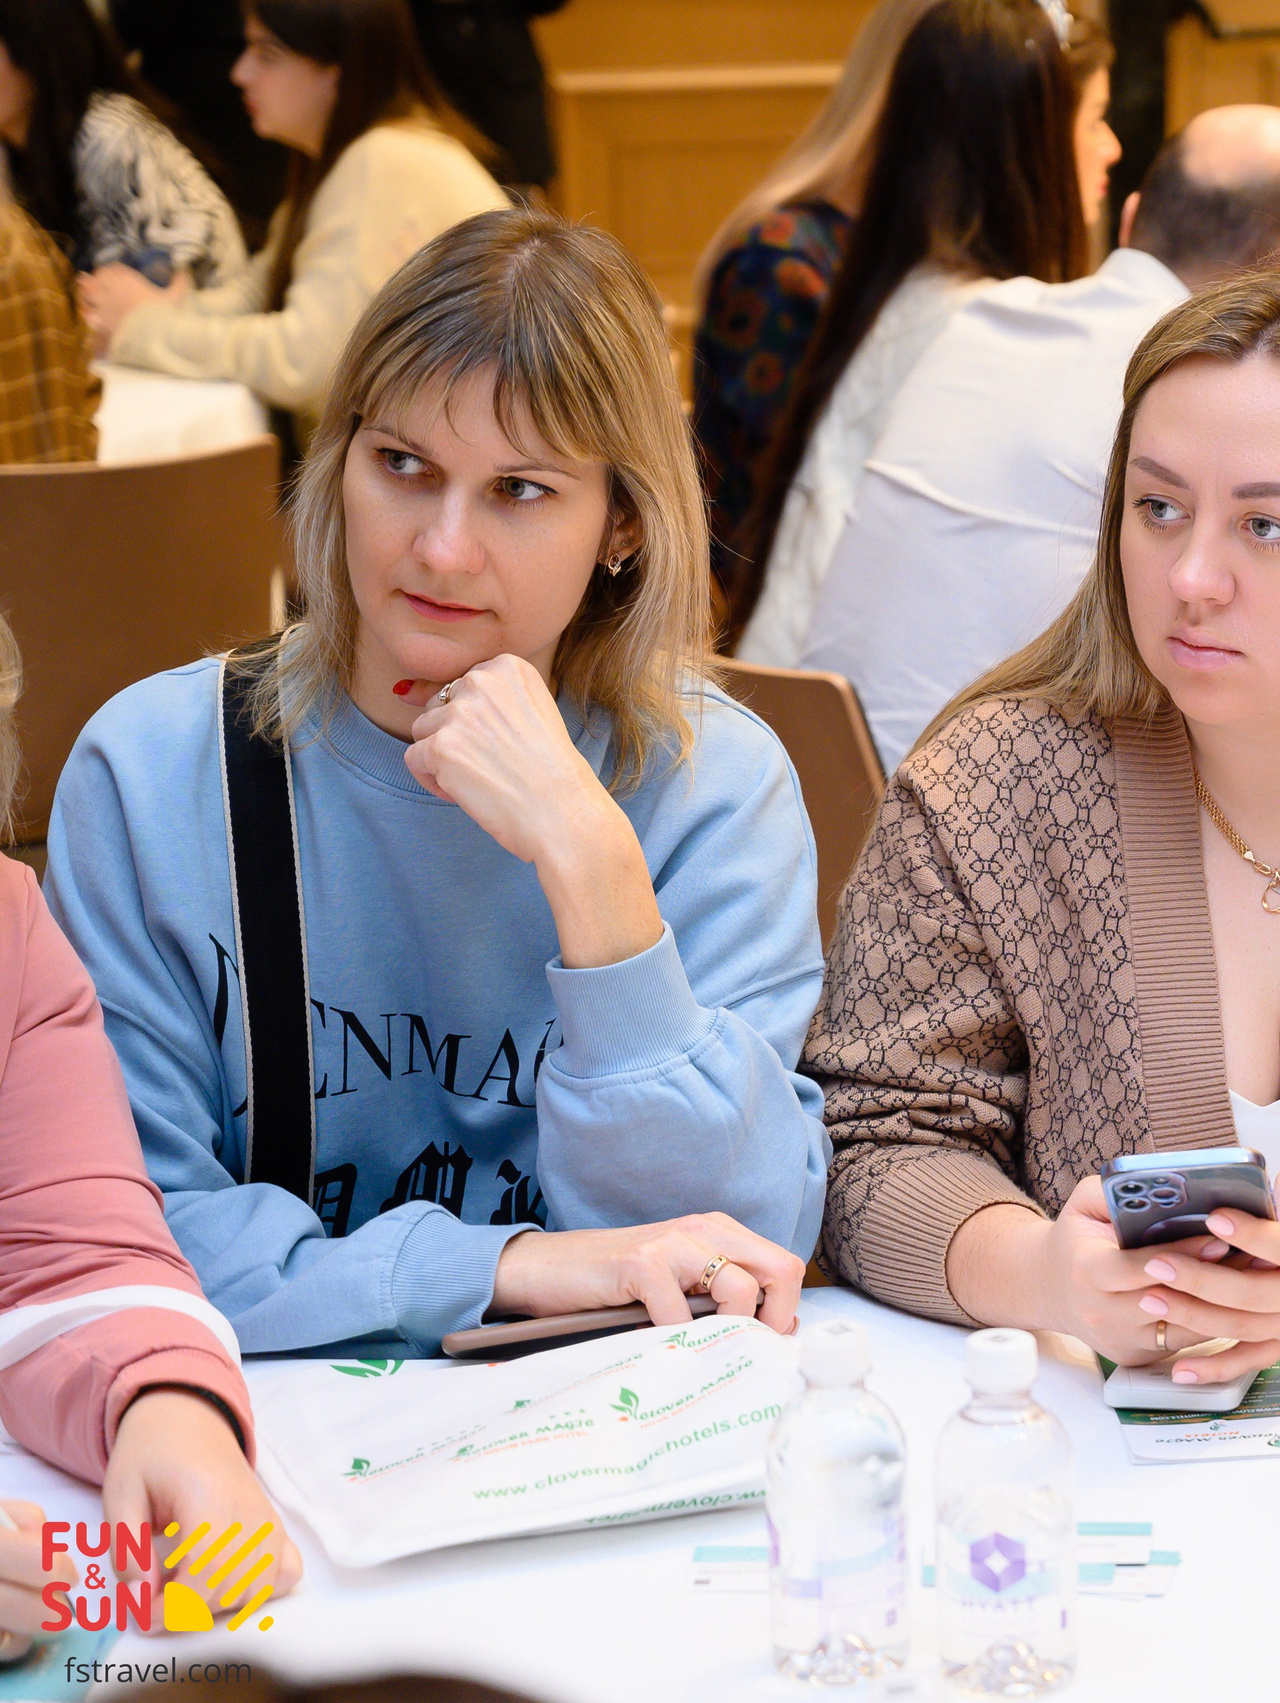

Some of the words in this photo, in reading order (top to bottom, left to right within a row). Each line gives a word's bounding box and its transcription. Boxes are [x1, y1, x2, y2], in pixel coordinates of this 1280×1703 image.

[640, 1393, 695, 1421] CLOVER
[535, 1418, 595, 1435] MAGIC
[472, 1402, 782, 1500] www.clovermagichotels.com
